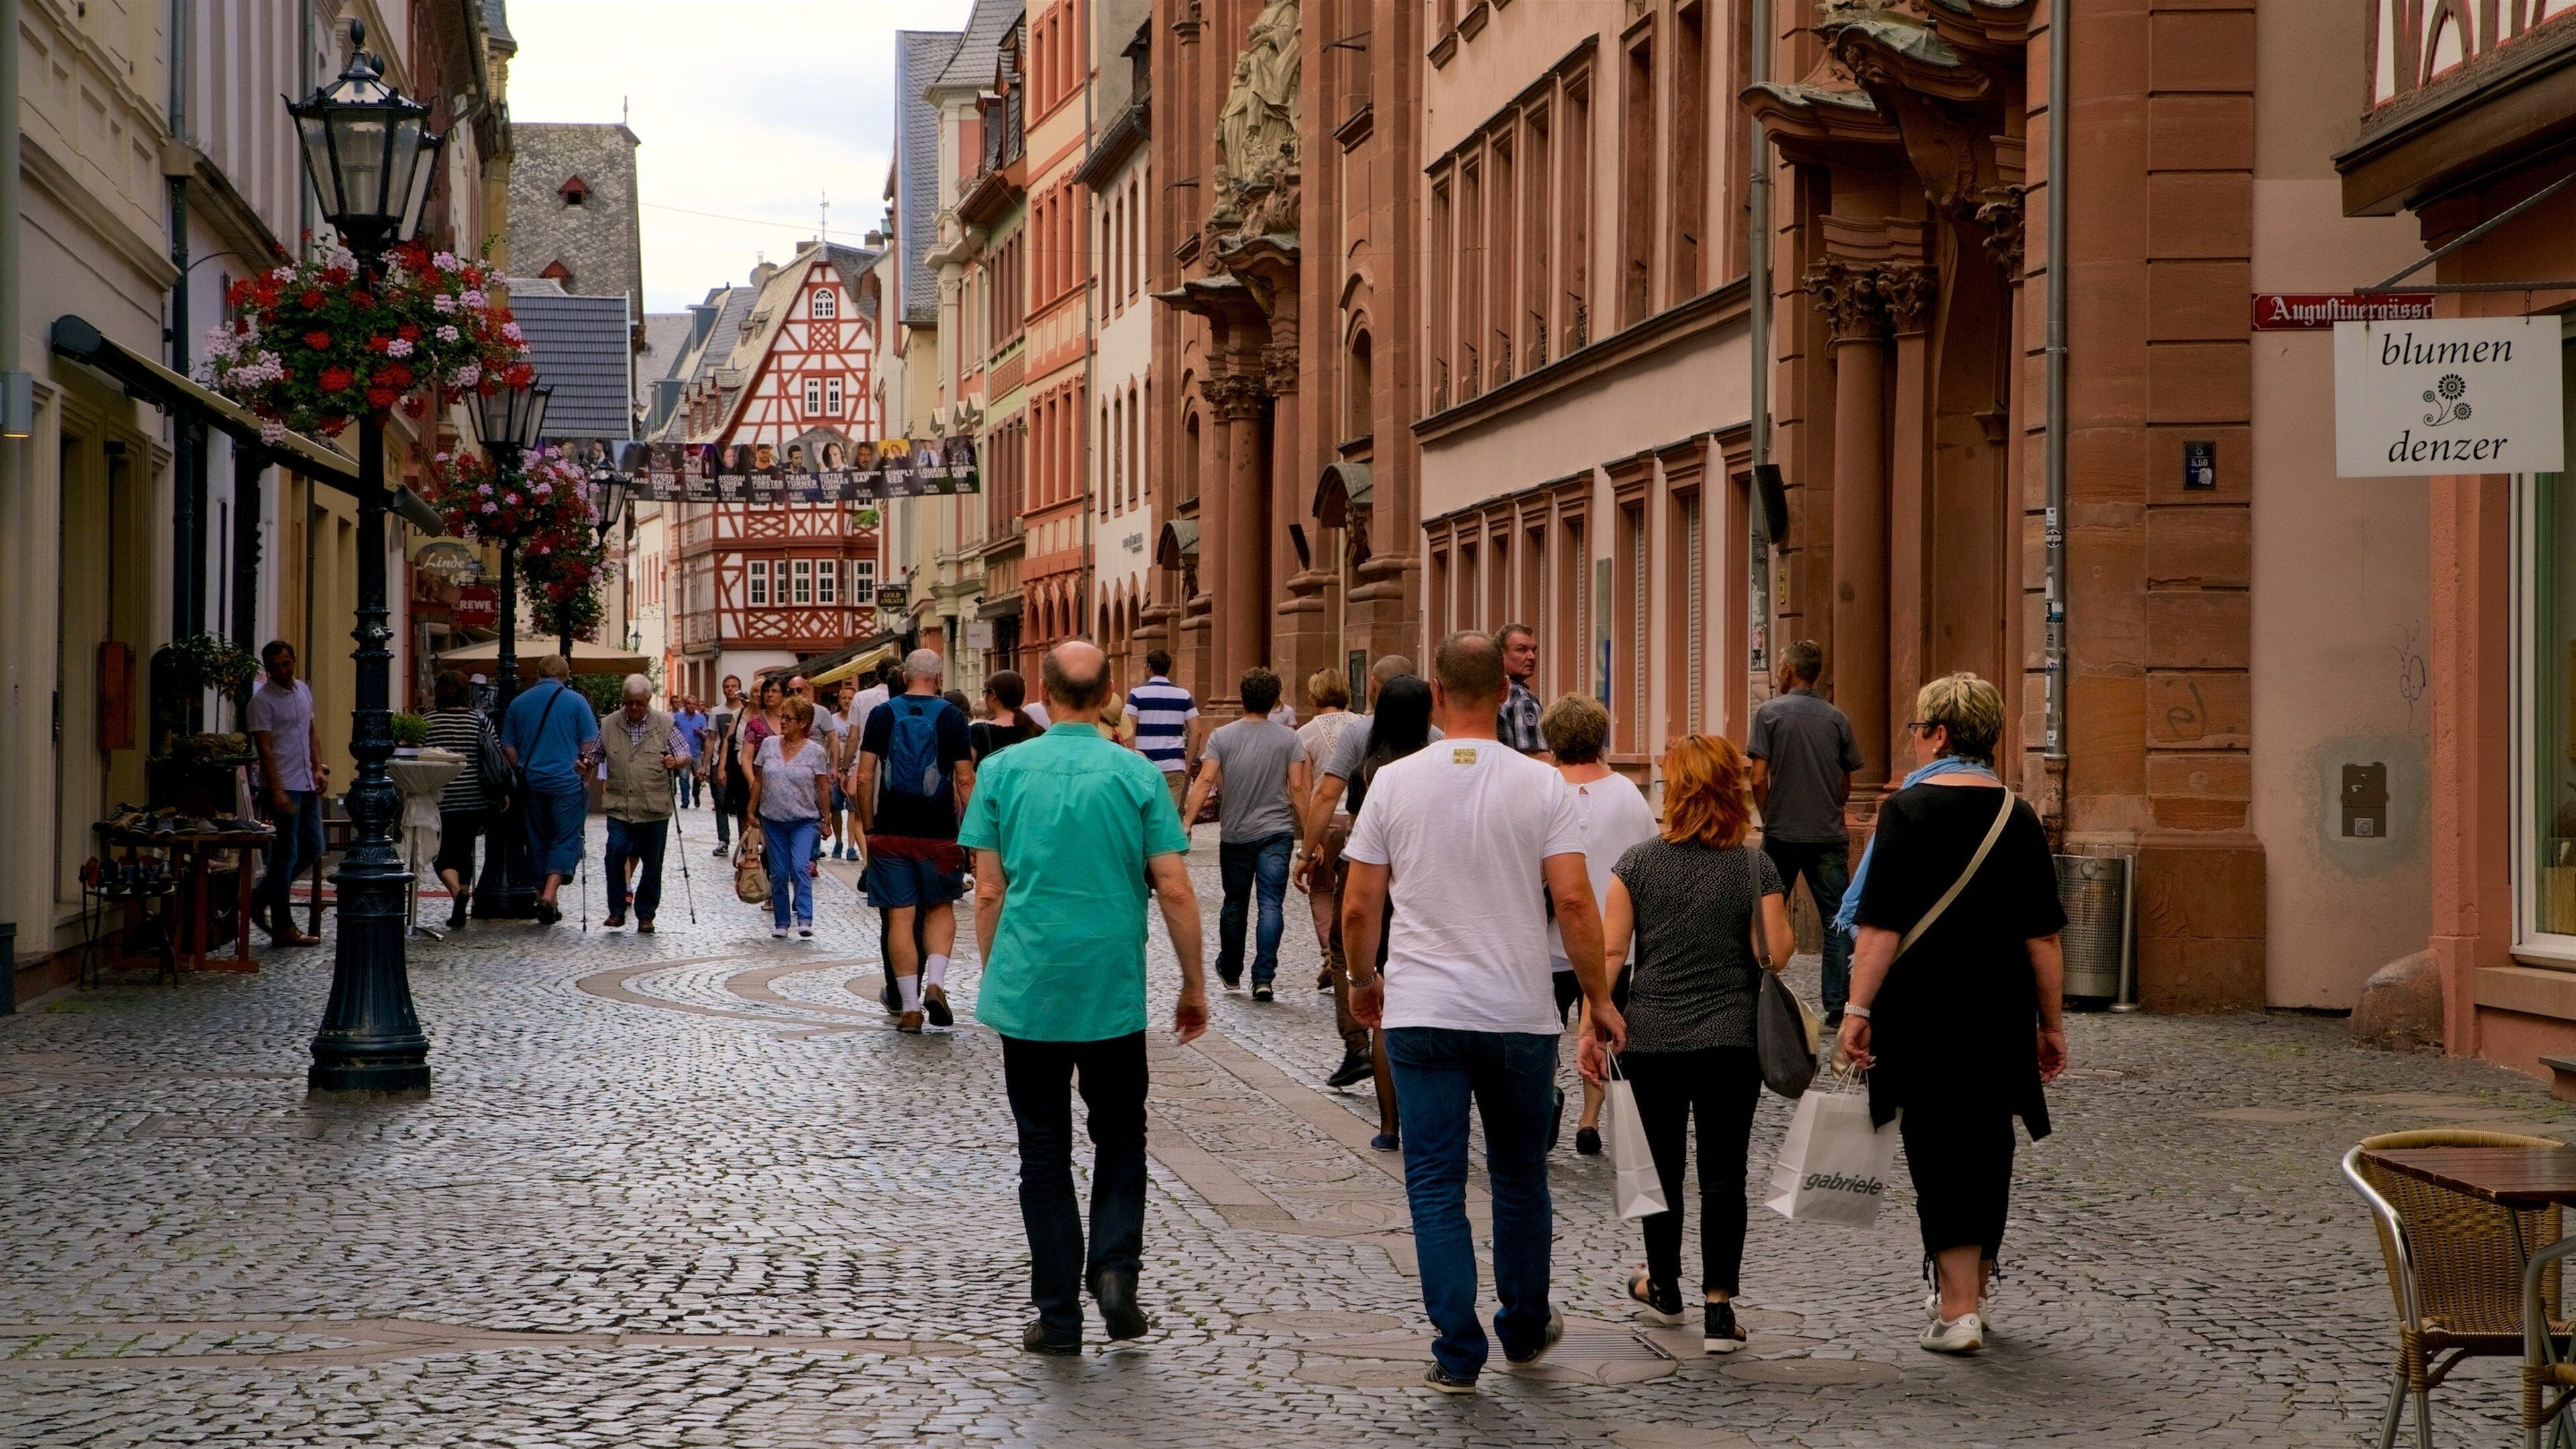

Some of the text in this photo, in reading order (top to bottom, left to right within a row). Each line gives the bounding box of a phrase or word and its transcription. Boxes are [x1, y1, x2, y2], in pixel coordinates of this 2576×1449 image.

[2381, 332, 2512, 366] blumen
[2388, 429, 2508, 463] denzer
[885, 469, 914, 477] SIMPLY
[918, 467, 947, 475] LOUANE
[818, 472, 843, 481] DIETER
[886, 476, 904, 484] RED
[752, 479, 784, 487] FORSTER
[424, 552, 465, 568] Linde
[460, 600, 492, 609] REWE
[1803, 1171, 1884, 1195] gabriele
